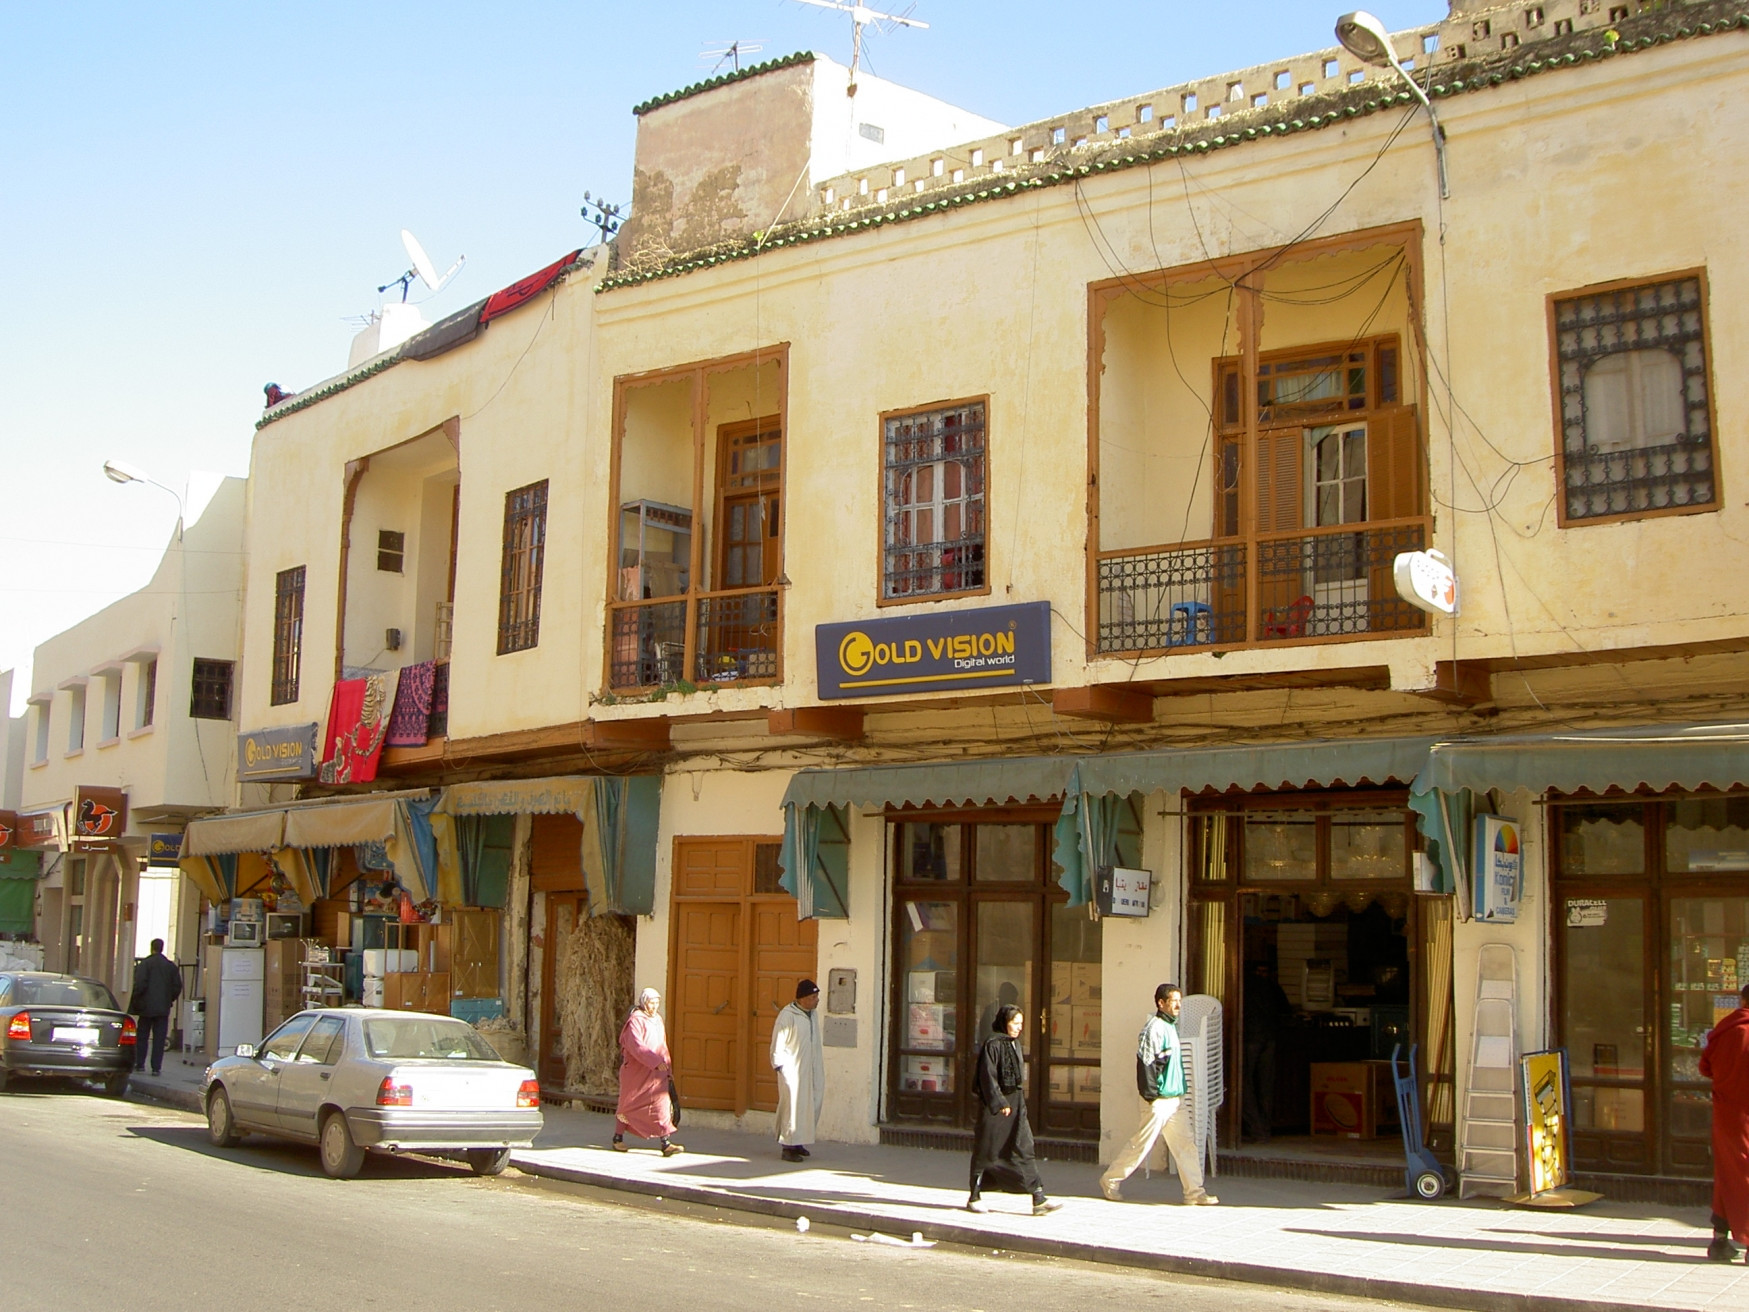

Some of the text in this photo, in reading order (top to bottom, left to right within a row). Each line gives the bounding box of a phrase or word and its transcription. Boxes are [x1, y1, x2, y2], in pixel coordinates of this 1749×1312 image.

[838, 630, 1015, 676] GOLD VISION
[954, 654, 1015, 669] Digital world
[245, 738, 302, 767] GOLD VISION
[1495, 871, 1516, 887] Konic
[1567, 899, 1607, 907] DURACELL
